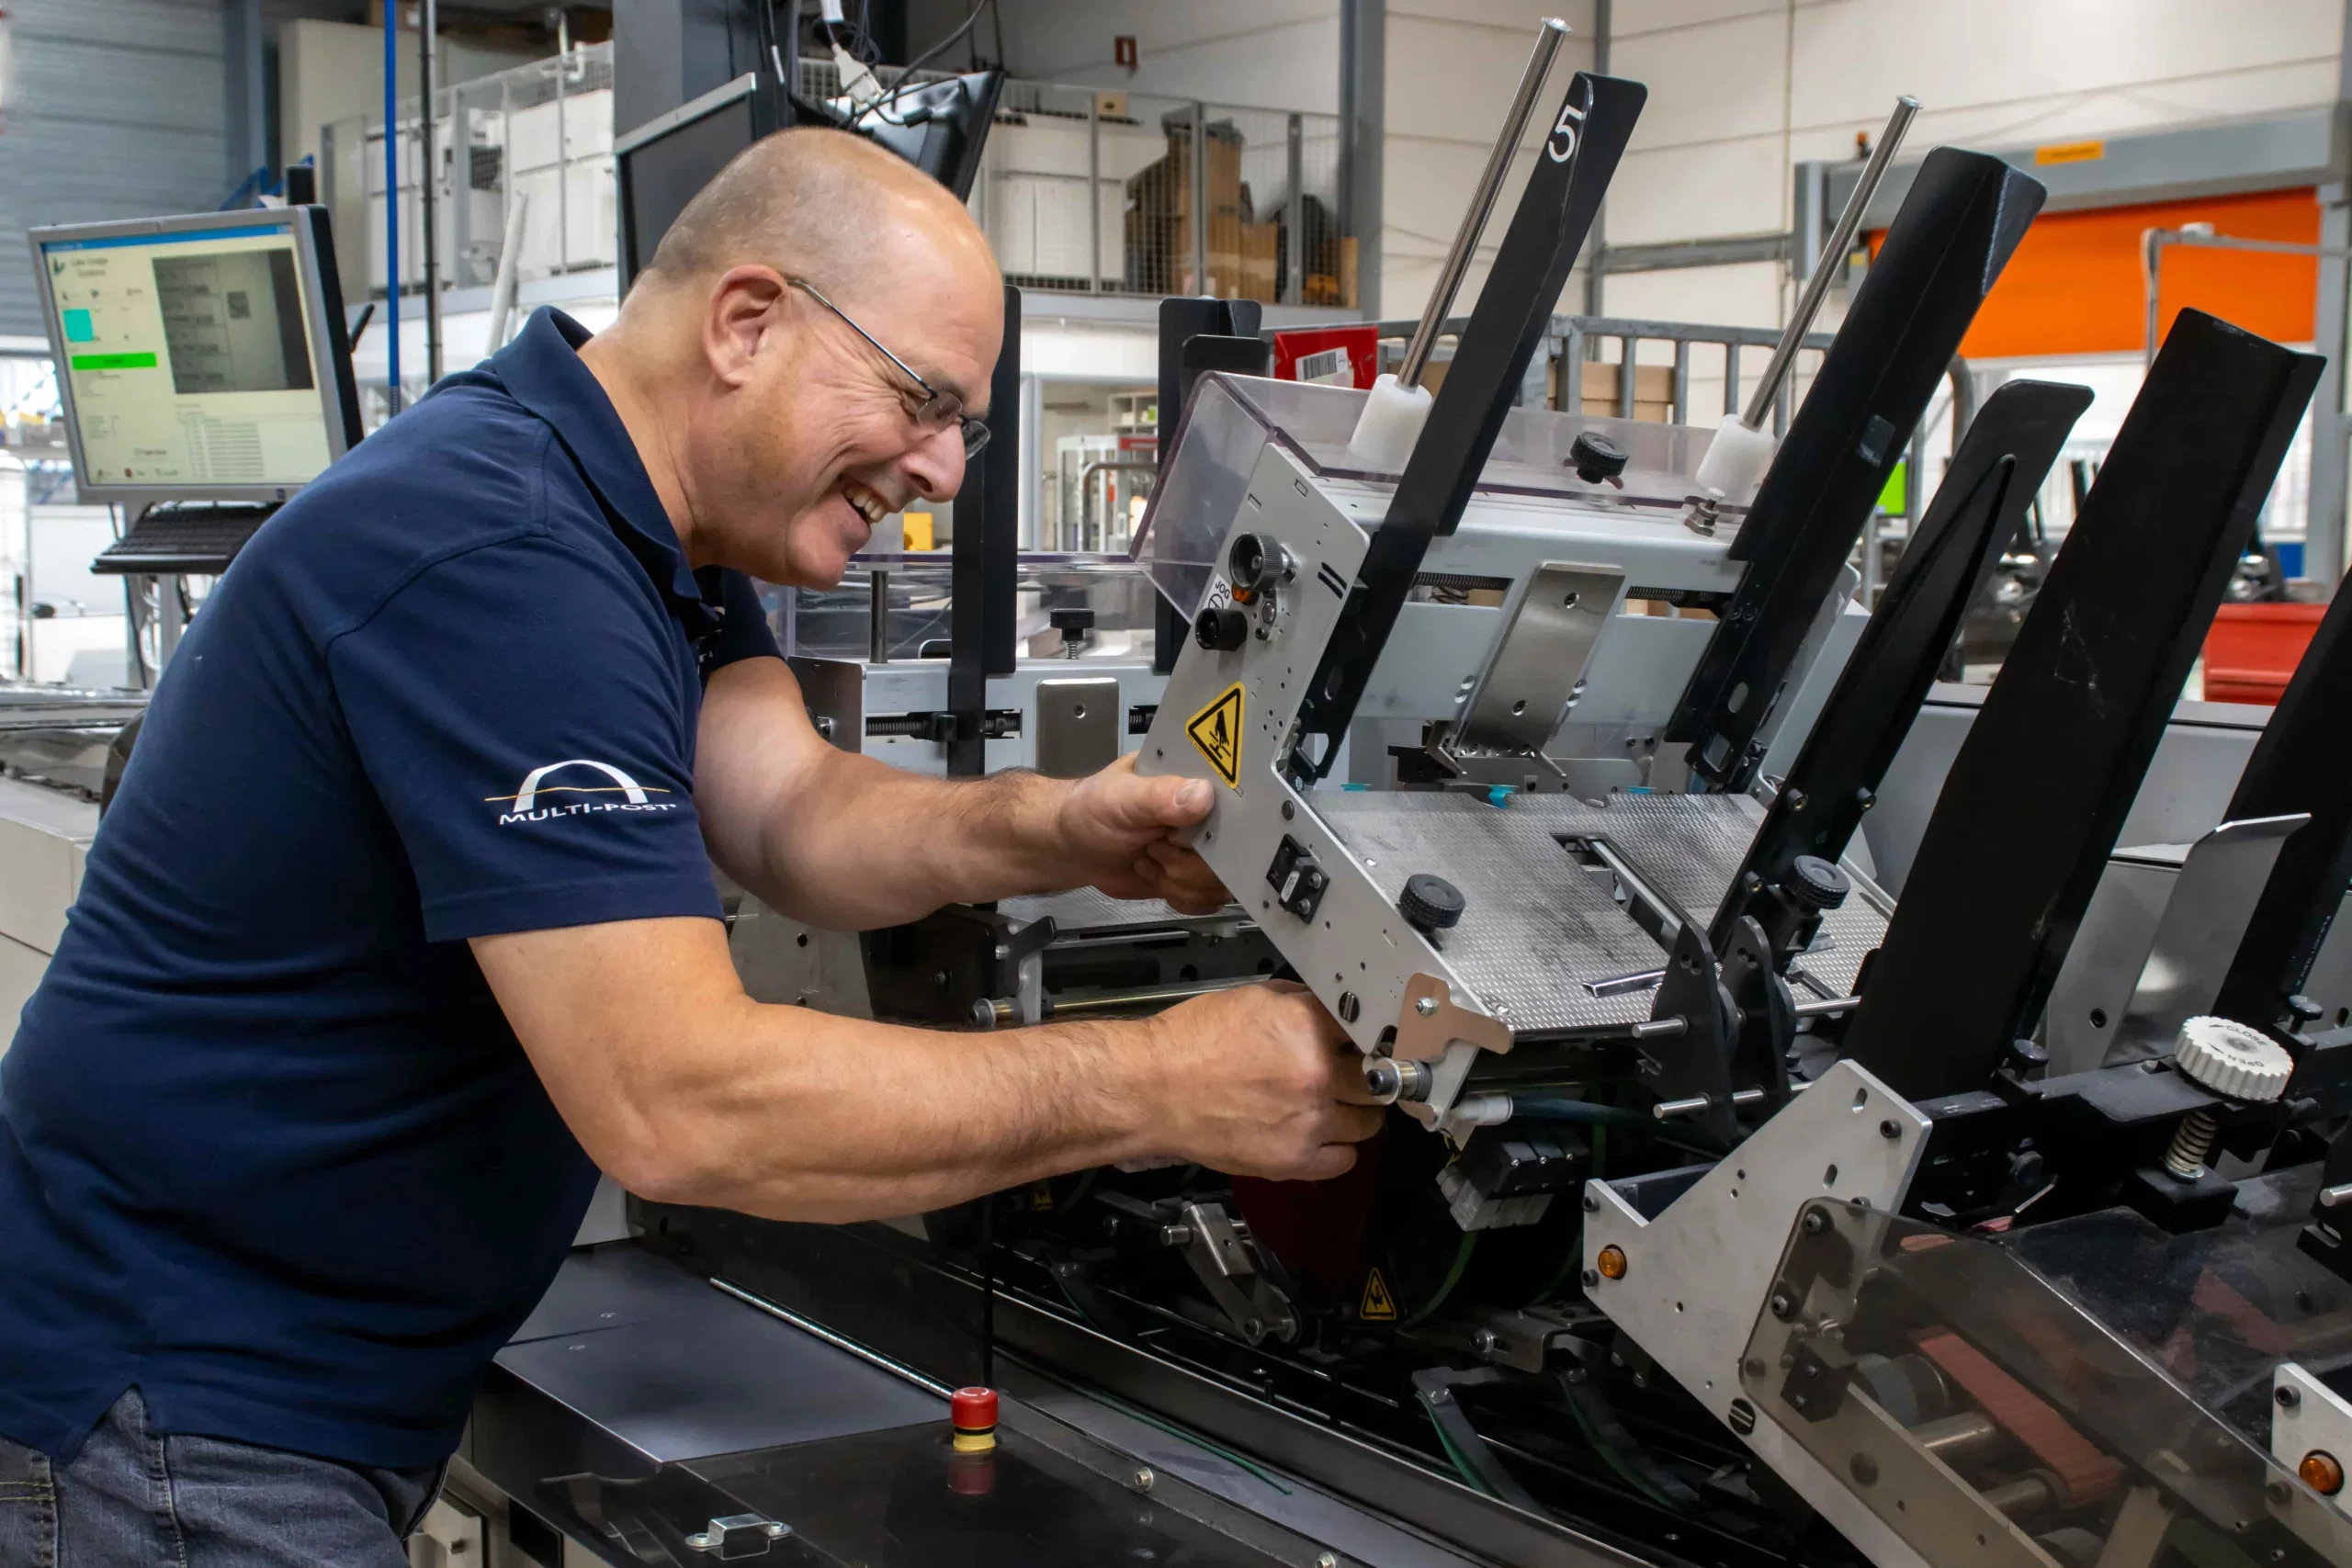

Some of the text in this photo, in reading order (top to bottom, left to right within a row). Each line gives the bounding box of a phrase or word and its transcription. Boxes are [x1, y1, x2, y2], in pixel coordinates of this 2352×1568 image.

[1548, 104, 1587, 163] 5
[1215, 581, 1231, 600] JOG
[2226, 1025, 2267, 1045] CLOSE
[2227, 1055, 2265, 1067] OPEN
